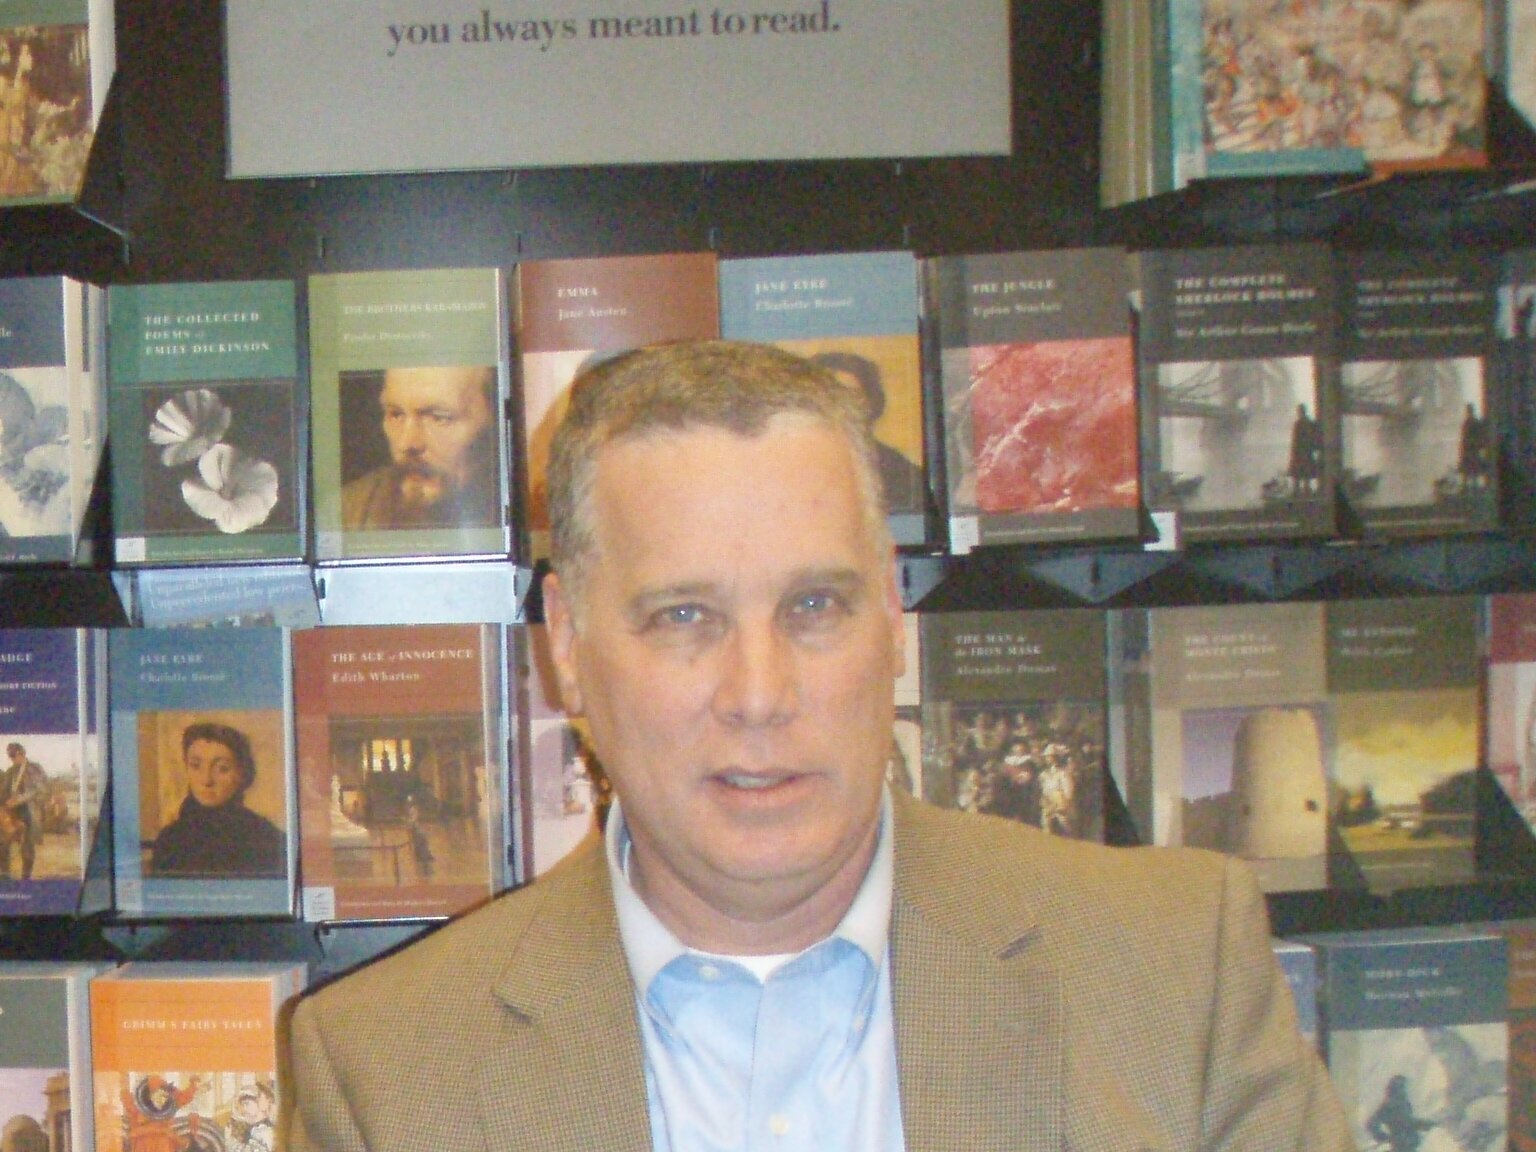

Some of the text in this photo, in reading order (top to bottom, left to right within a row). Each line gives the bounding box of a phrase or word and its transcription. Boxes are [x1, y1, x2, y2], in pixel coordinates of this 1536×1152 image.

[387, 2, 841, 57] you always meant to read.
[558, 286, 599, 299] EMMA
[755, 277, 829, 294] JANE EYRE
[972, 278, 1056, 295] THE JUNGLE
[144, 310, 262, 327] THE COLLECTED
[144, 328, 190, 341] POEMS
[144, 340, 272, 357] EMILY DICKINSON
[955, 633, 1013, 647] THE MAN
[140, 651, 204, 667] JANE EYRE
[331, 648, 474, 665] THE AGE INNOCENCE
[969, 645, 1043, 659] IRON MASK
[332, 668, 421, 684] Edith Wharton
